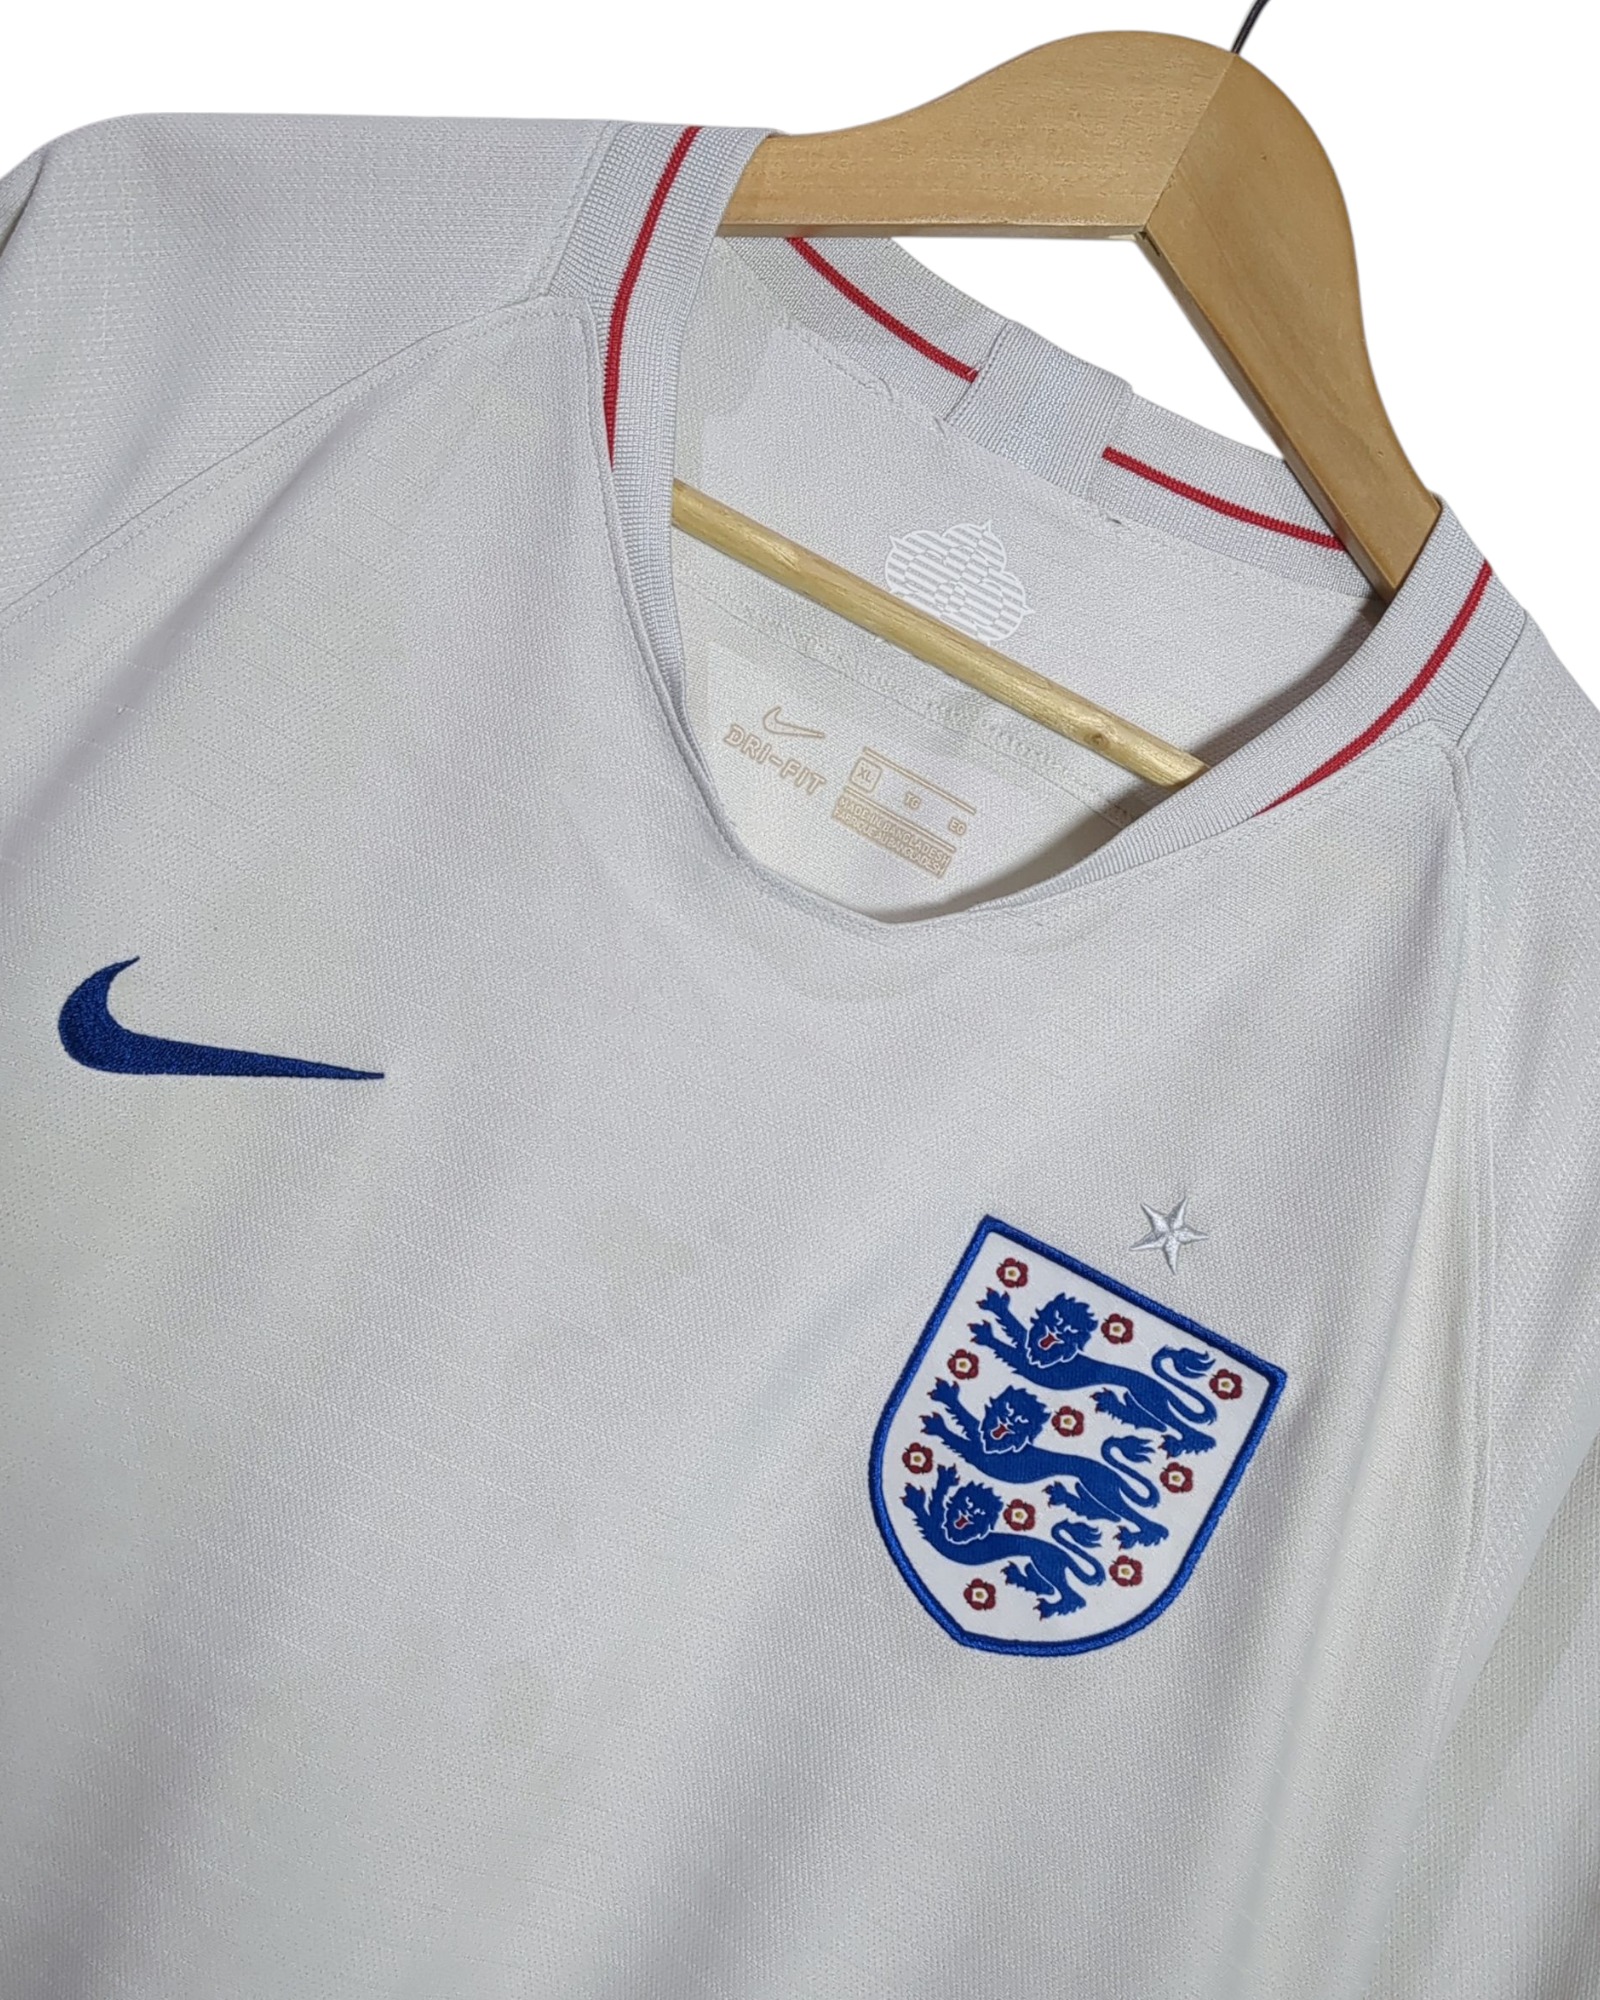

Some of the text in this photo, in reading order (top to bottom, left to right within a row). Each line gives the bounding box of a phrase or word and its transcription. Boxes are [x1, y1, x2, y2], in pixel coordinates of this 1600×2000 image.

[723, 724, 827, 795] DRI-FIT
[857, 767, 873, 783] XL
[837, 797, 869, 820] MADE
[882, 822, 951, 867] BANGLADESH
